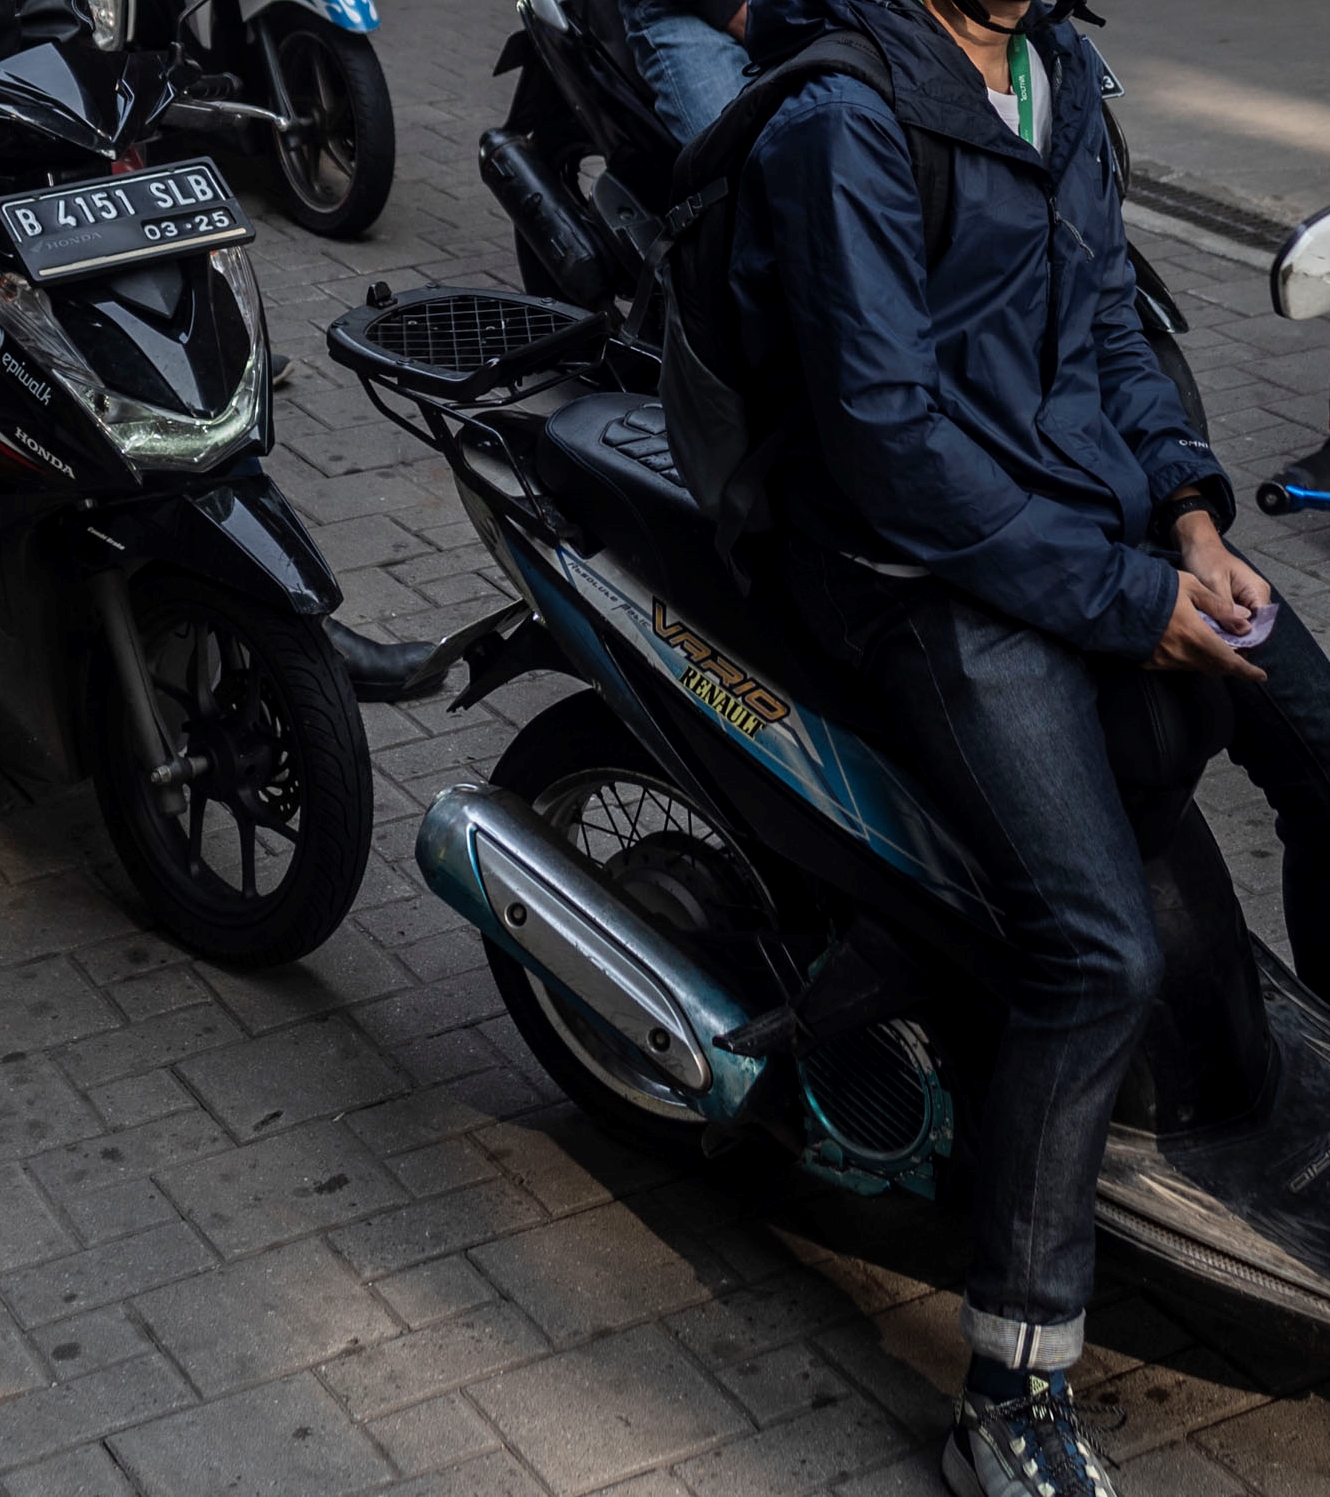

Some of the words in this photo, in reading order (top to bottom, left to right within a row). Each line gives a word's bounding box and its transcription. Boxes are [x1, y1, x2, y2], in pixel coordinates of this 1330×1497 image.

[15, 208, 43, 237] B
[57, 189, 136, 227] 4151
[149, 174, 215, 209] SLB
[45, 232, 103, 251] HONDA
[2, 352, 53, 407] epiwalk
[14, 426, 76, 480] HONDA
[651, 595, 792, 724] VARIO
[679, 665, 767, 741] RENAULT
